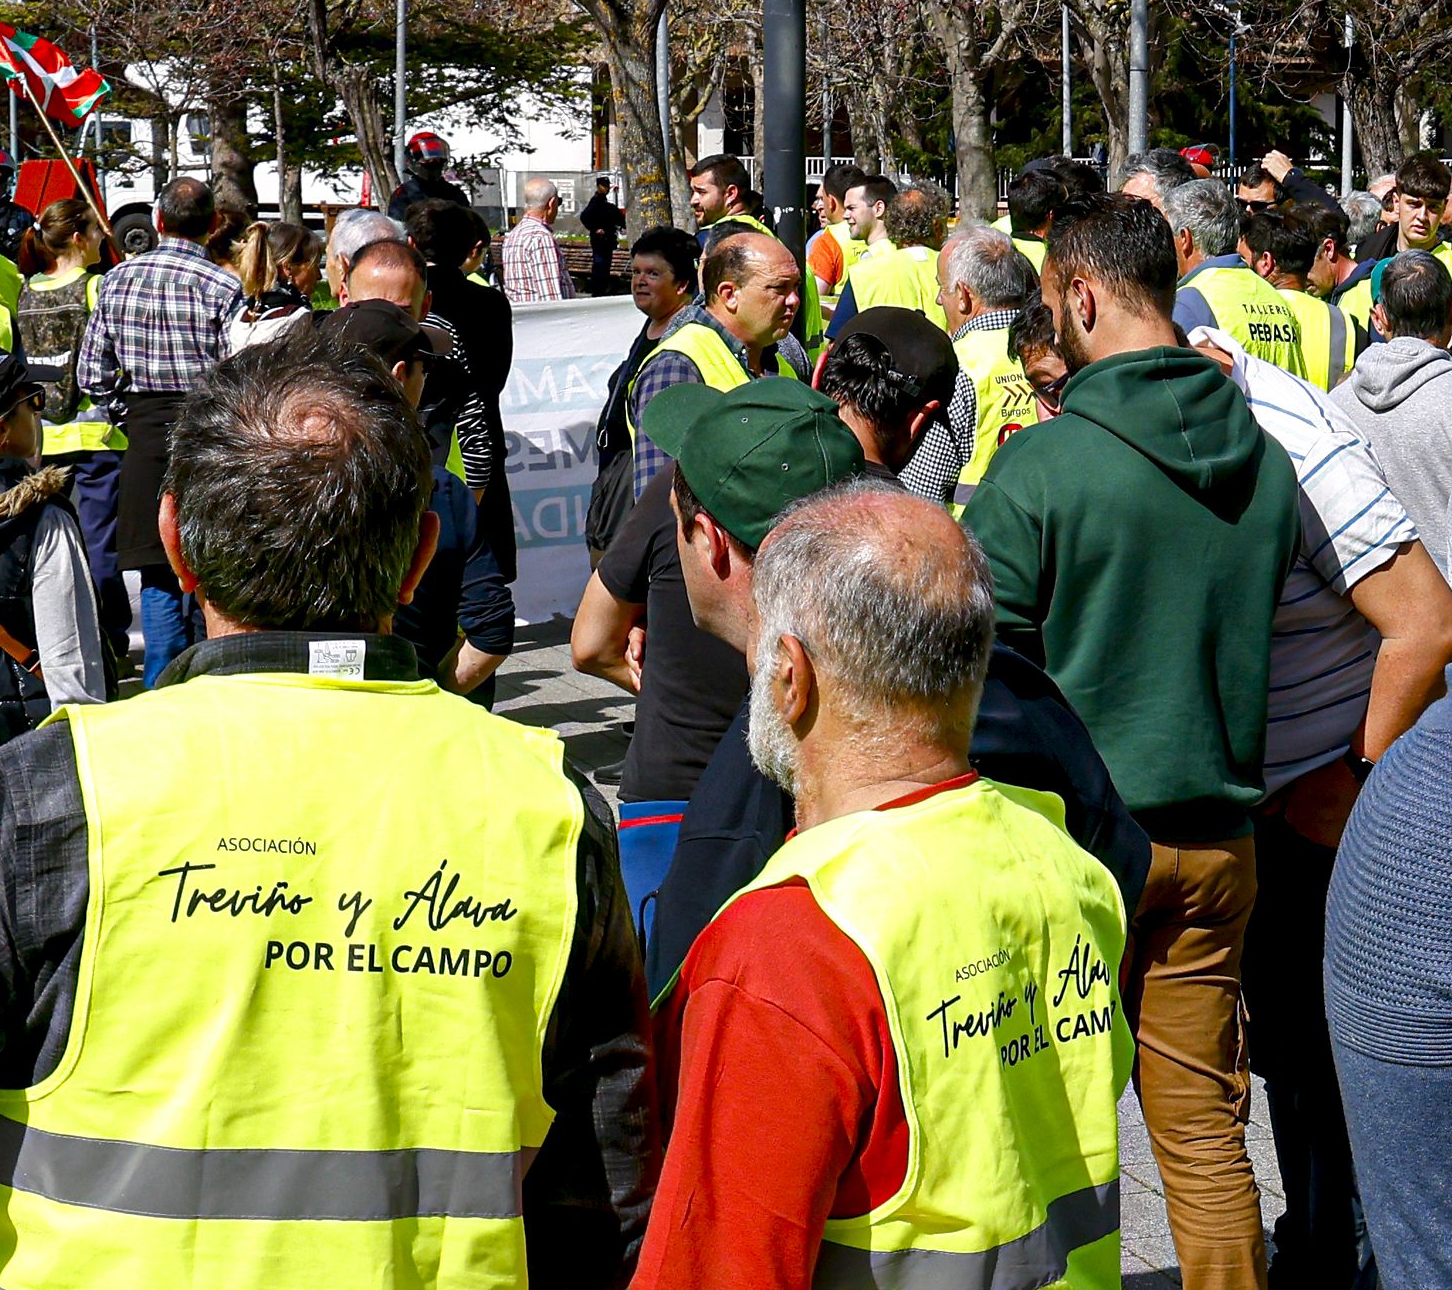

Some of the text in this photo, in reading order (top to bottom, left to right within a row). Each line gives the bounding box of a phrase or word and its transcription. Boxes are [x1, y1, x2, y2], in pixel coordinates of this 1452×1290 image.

[1248, 322, 1298, 345] PEBASA
[995, 373, 1023, 385] UNION
[1001, 408, 1031, 418] Burgos
[216, 836, 317, 856] ASOCIACIÓN
[158, 859, 518, 938] Treviño y Álava
[264, 939, 513, 979] POR EL CAMPO
[954, 946, 1011, 983] ASOCIACIÓN
[926, 991, 1017, 1059] Treviño
[1024, 980, 1038, 1026] y
[1000, 1033, 1032, 1070] POR
[1033, 1024, 1050, 1054] EL
